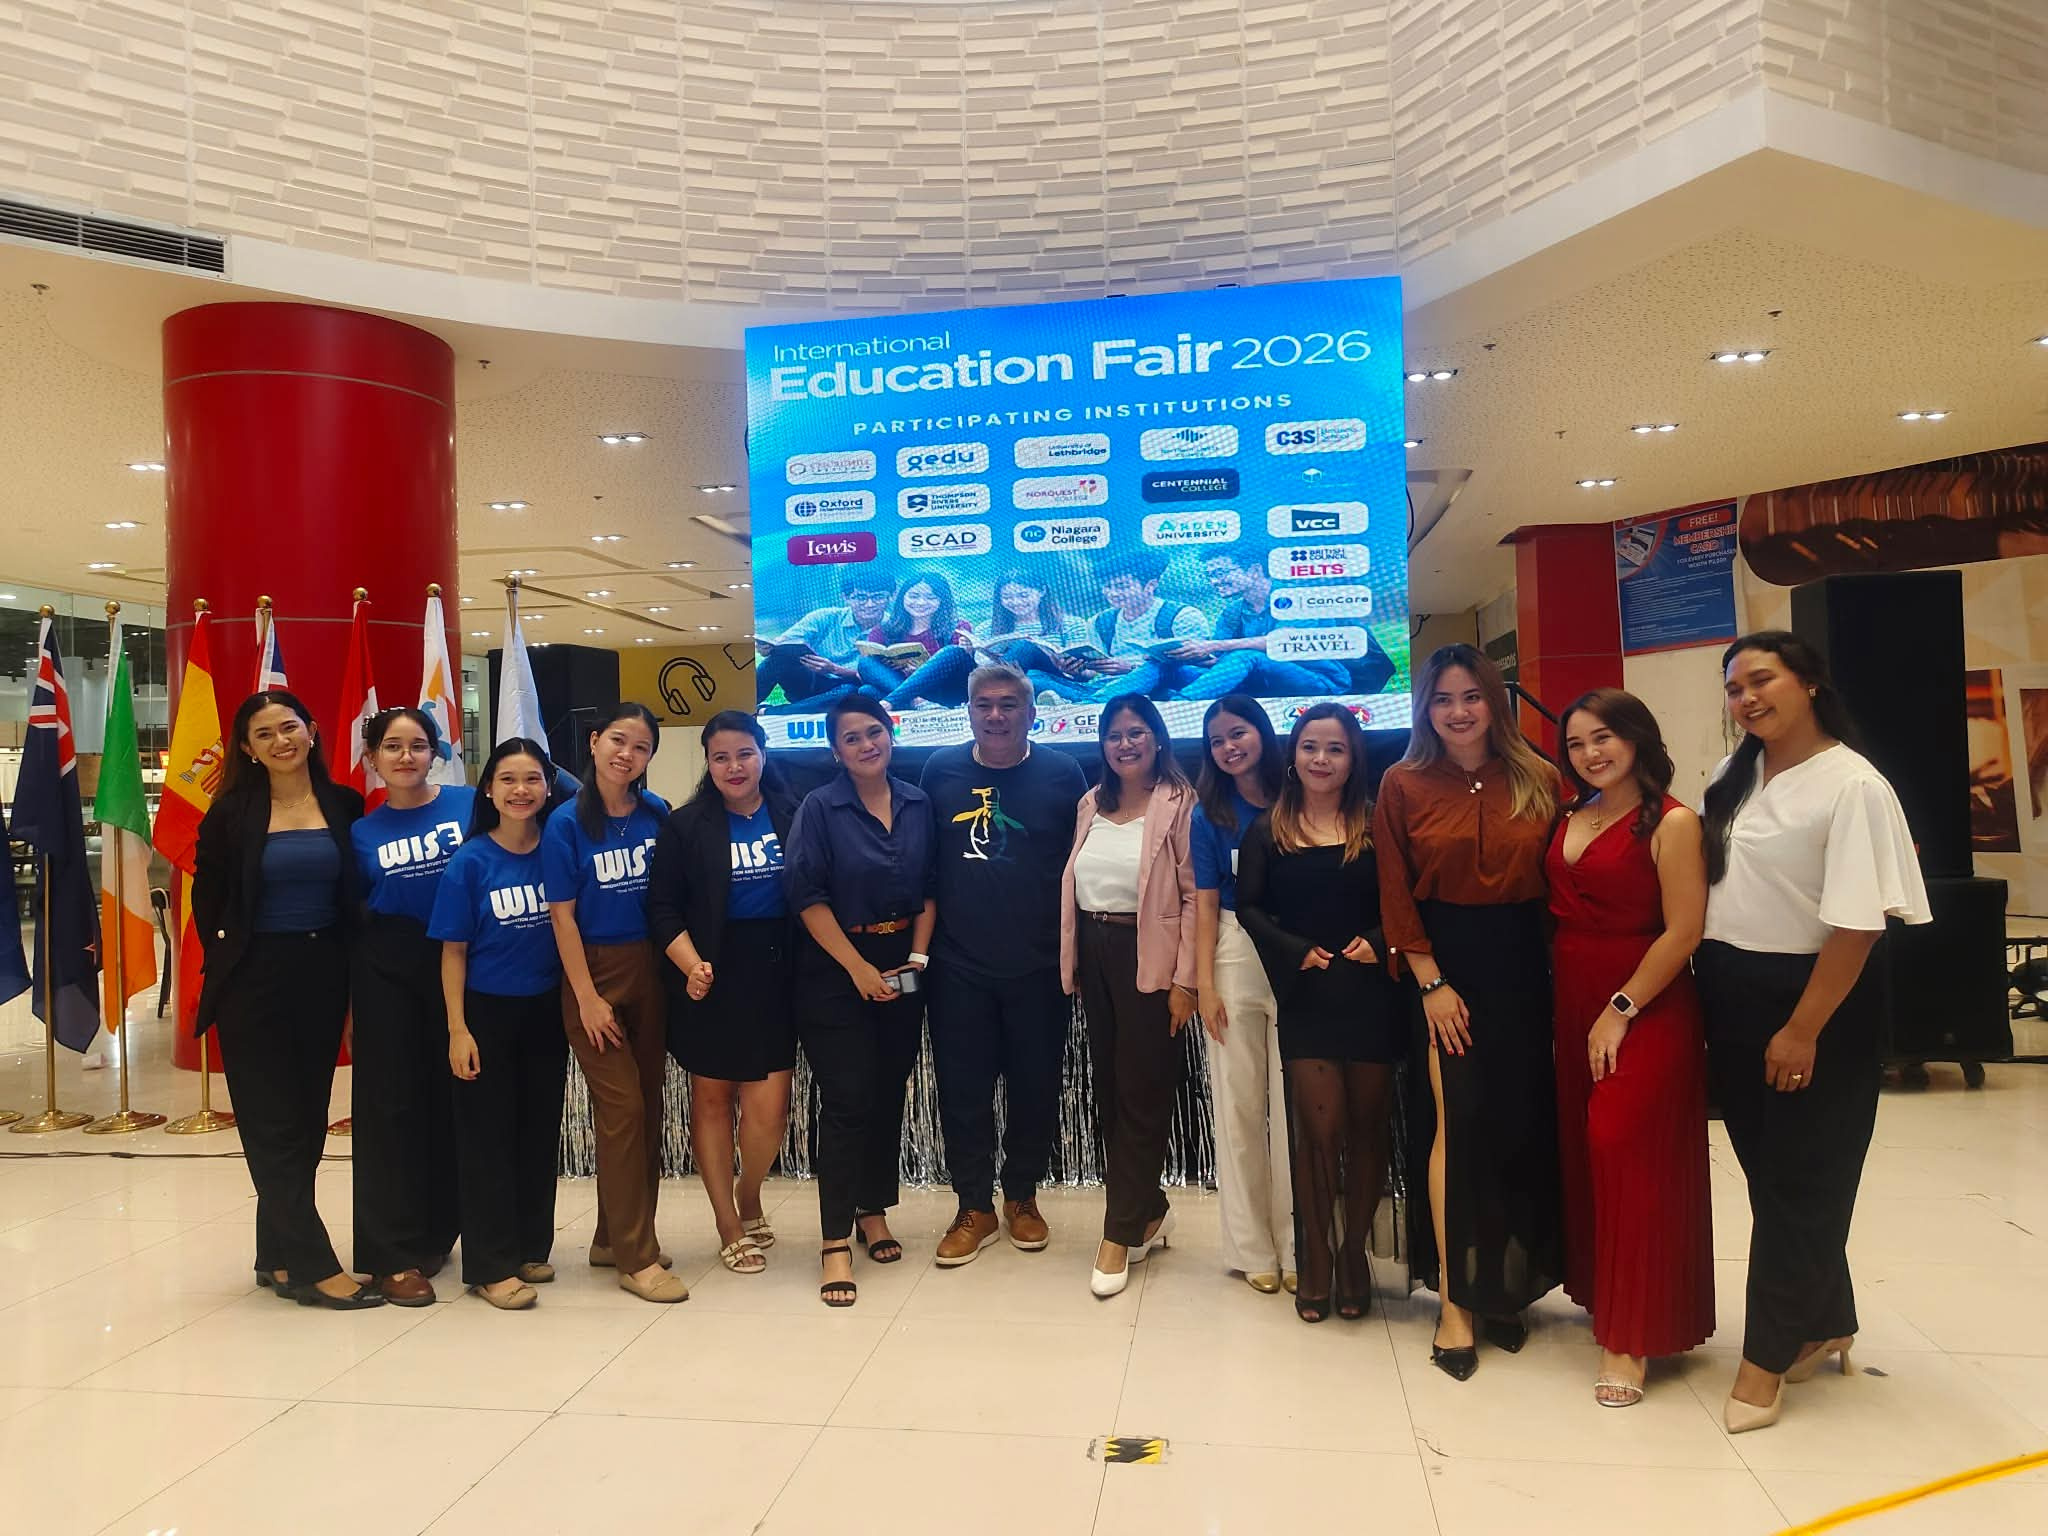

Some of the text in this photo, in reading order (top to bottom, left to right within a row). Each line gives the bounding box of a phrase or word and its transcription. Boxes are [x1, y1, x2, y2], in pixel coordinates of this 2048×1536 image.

[774, 331, 951, 362] International
[770, 330, 1372, 401] Education Fair 2026
[853, 394, 1292, 436] PARTICIPATING INSTITUTIONS
[1276, 429, 1316, 446] C3S
[1048, 447, 1107, 457] Lethbridge
[1151, 477, 1229, 488] CENTENNIAL
[1026, 488, 1079, 498] NORQUEST
[1180, 484, 1229, 493] COLLEGE
[931, 491, 976, 500] THOMPSON
[819, 498, 863, 508] Oxford
[1689, 512, 1718, 528] FREE!
[1051, 525, 1101, 536] Niagara
[1157, 529, 1228, 540] UNIVERSITY
[911, 531, 977, 548] SCAD
[1051, 534, 1098, 545] College
[808, 539, 857, 557] Lewis
[1309, 548, 1345, 556] BRITISH
[1309, 553, 1347, 561] COUNCIL
[1290, 563, 1344, 577] IELTS
[1306, 596, 1370, 605] CanCare
[1289, 632, 1344, 641] WISEBOX
[1278, 640, 1355, 653] TRAVEL
[1073, 714, 1097, 726] GE
[787, 721, 825, 740] WI
[378, 821, 463, 869] WISE
[489, 882, 550, 919] WIS
